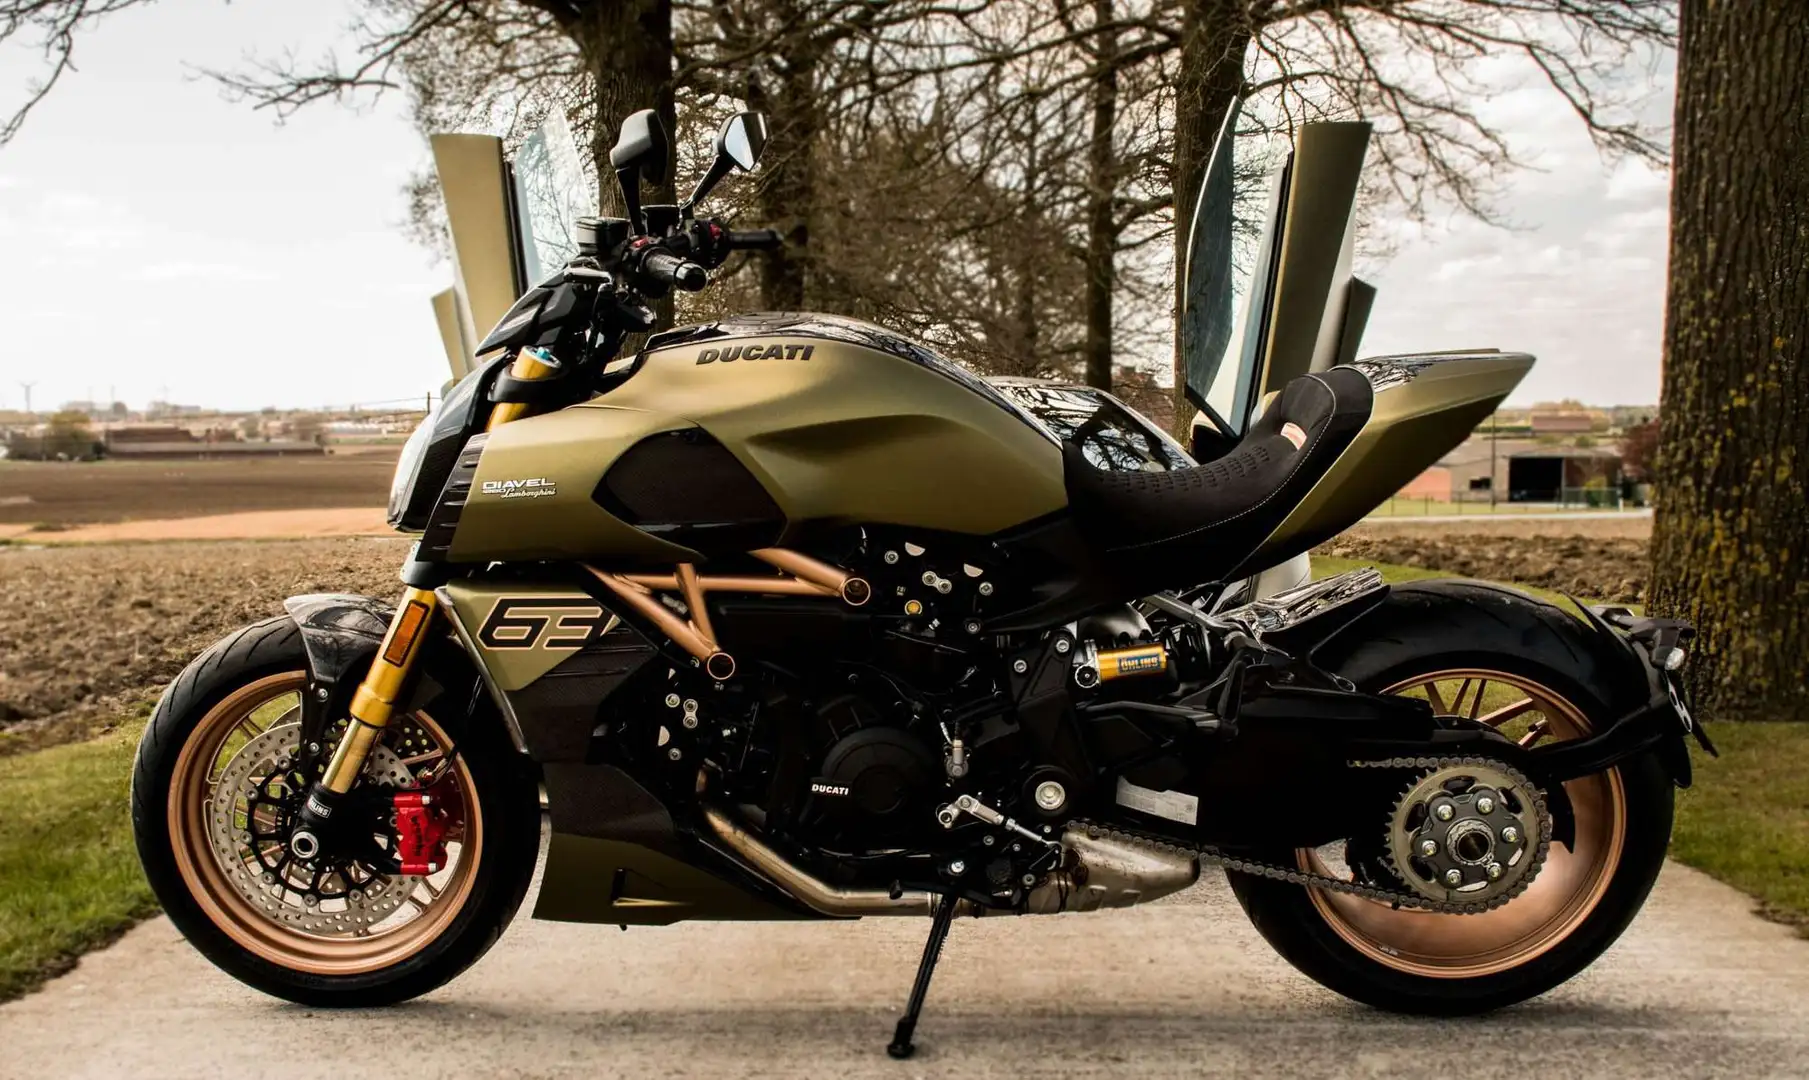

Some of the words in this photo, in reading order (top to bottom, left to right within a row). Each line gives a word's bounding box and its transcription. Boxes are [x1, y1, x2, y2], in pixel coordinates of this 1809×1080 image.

[696, 344, 815, 365] DUCATI
[482, 477, 556, 489] DIAVEL
[501, 488, 556, 498] Lamborghini
[477, 596, 612, 650] 63
[811, 783, 849, 795] DUCATI
